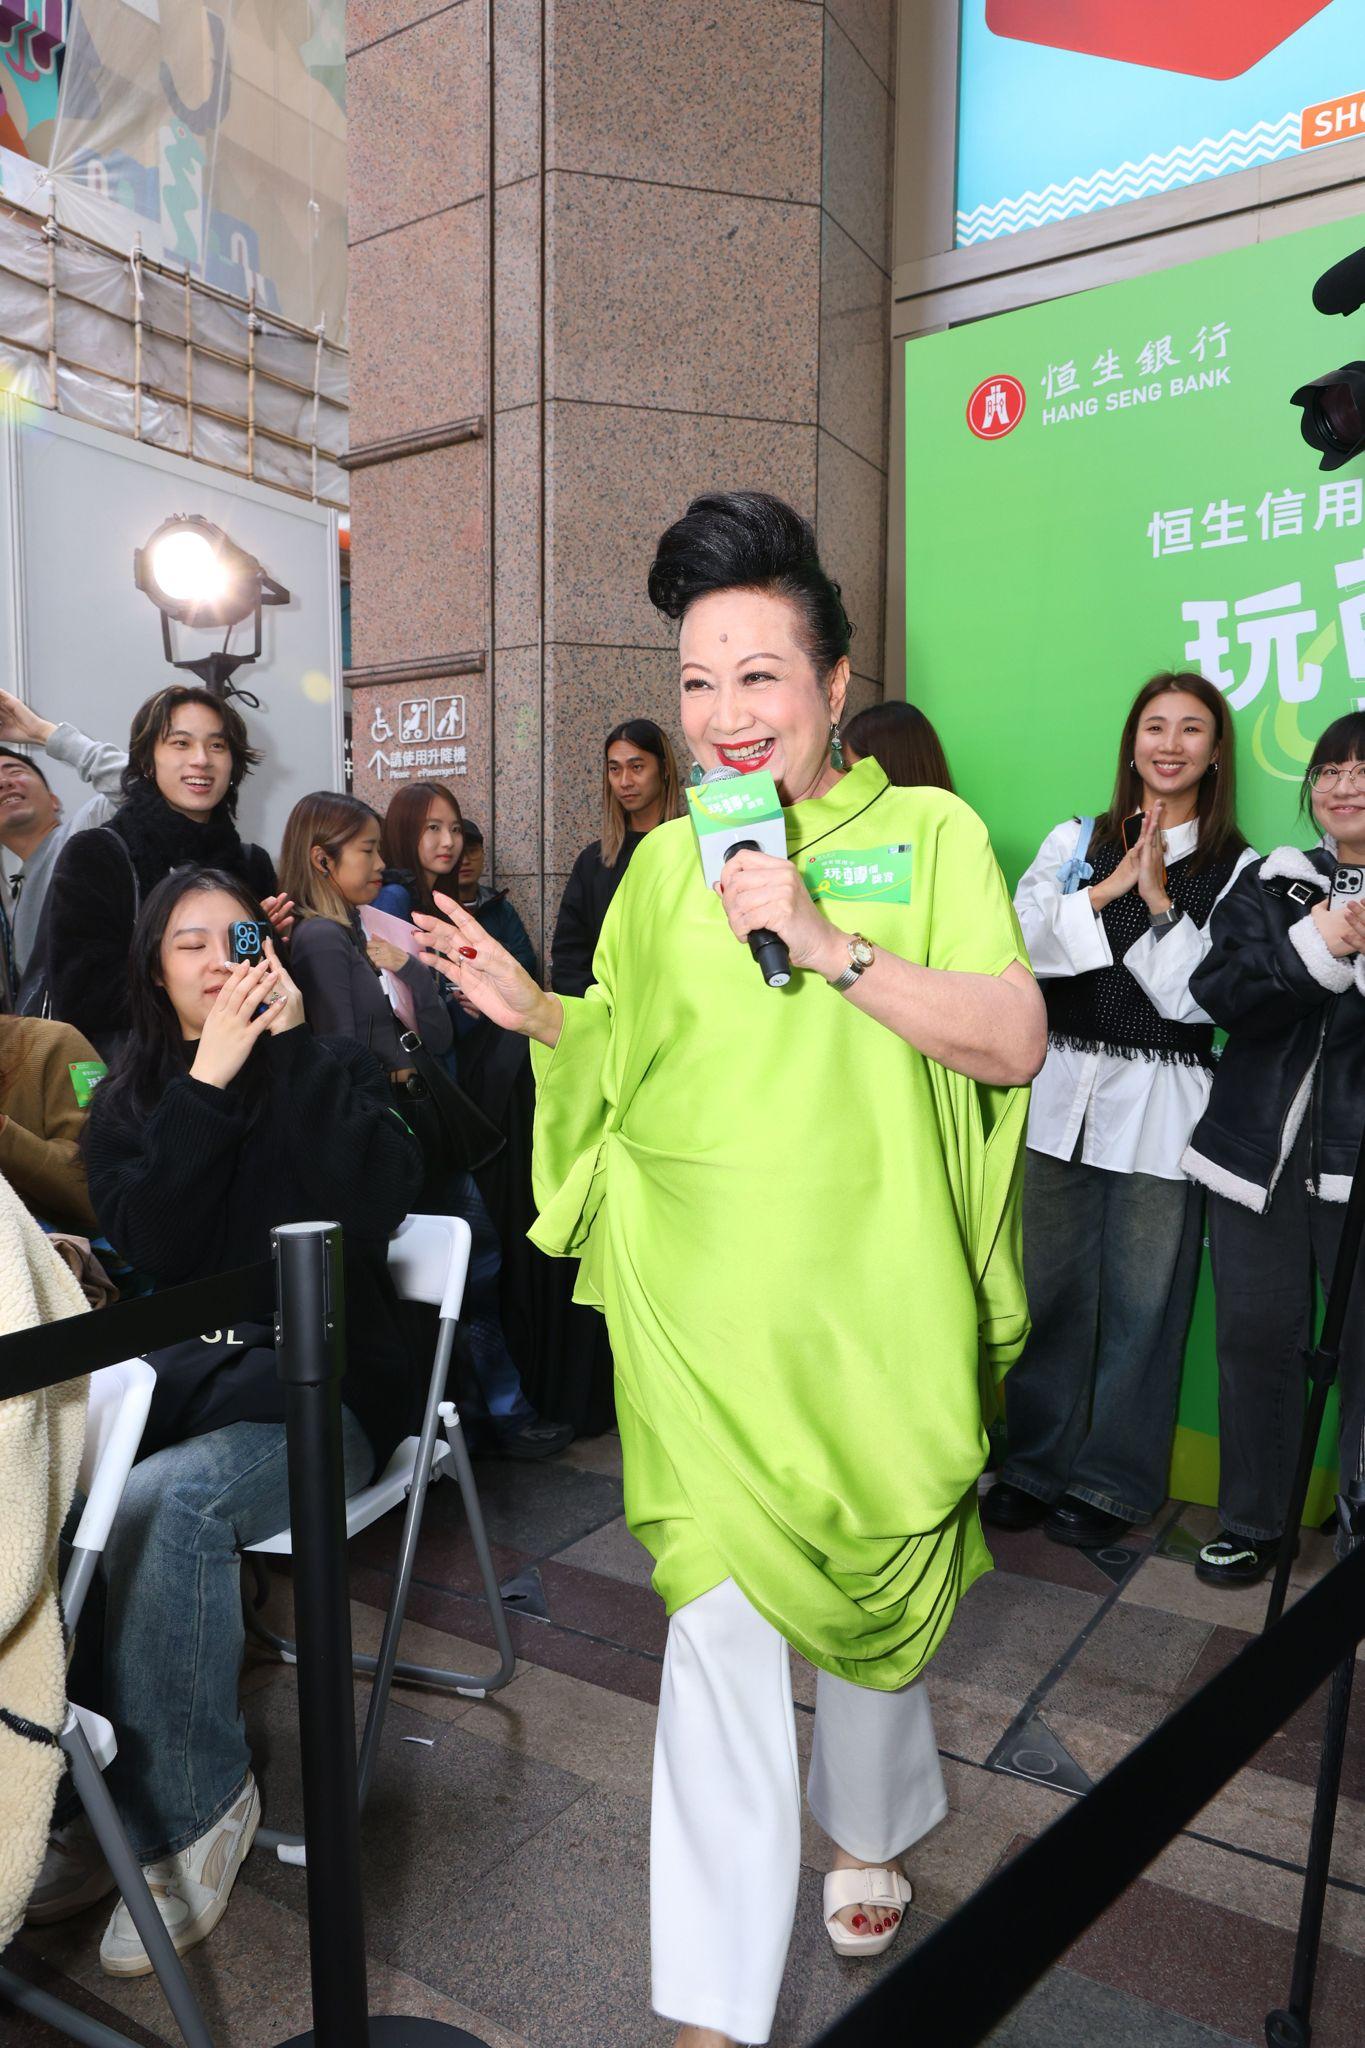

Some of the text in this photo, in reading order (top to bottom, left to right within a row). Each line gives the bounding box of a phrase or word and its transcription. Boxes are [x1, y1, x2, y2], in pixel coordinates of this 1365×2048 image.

[1040, 321, 1232, 400] 恒生銀行
[1041, 366, 1231, 426] HANG SENG BANK
[1146, 478, 1363, 558] 恒生信用
[1181, 550, 1365, 712] 玩
